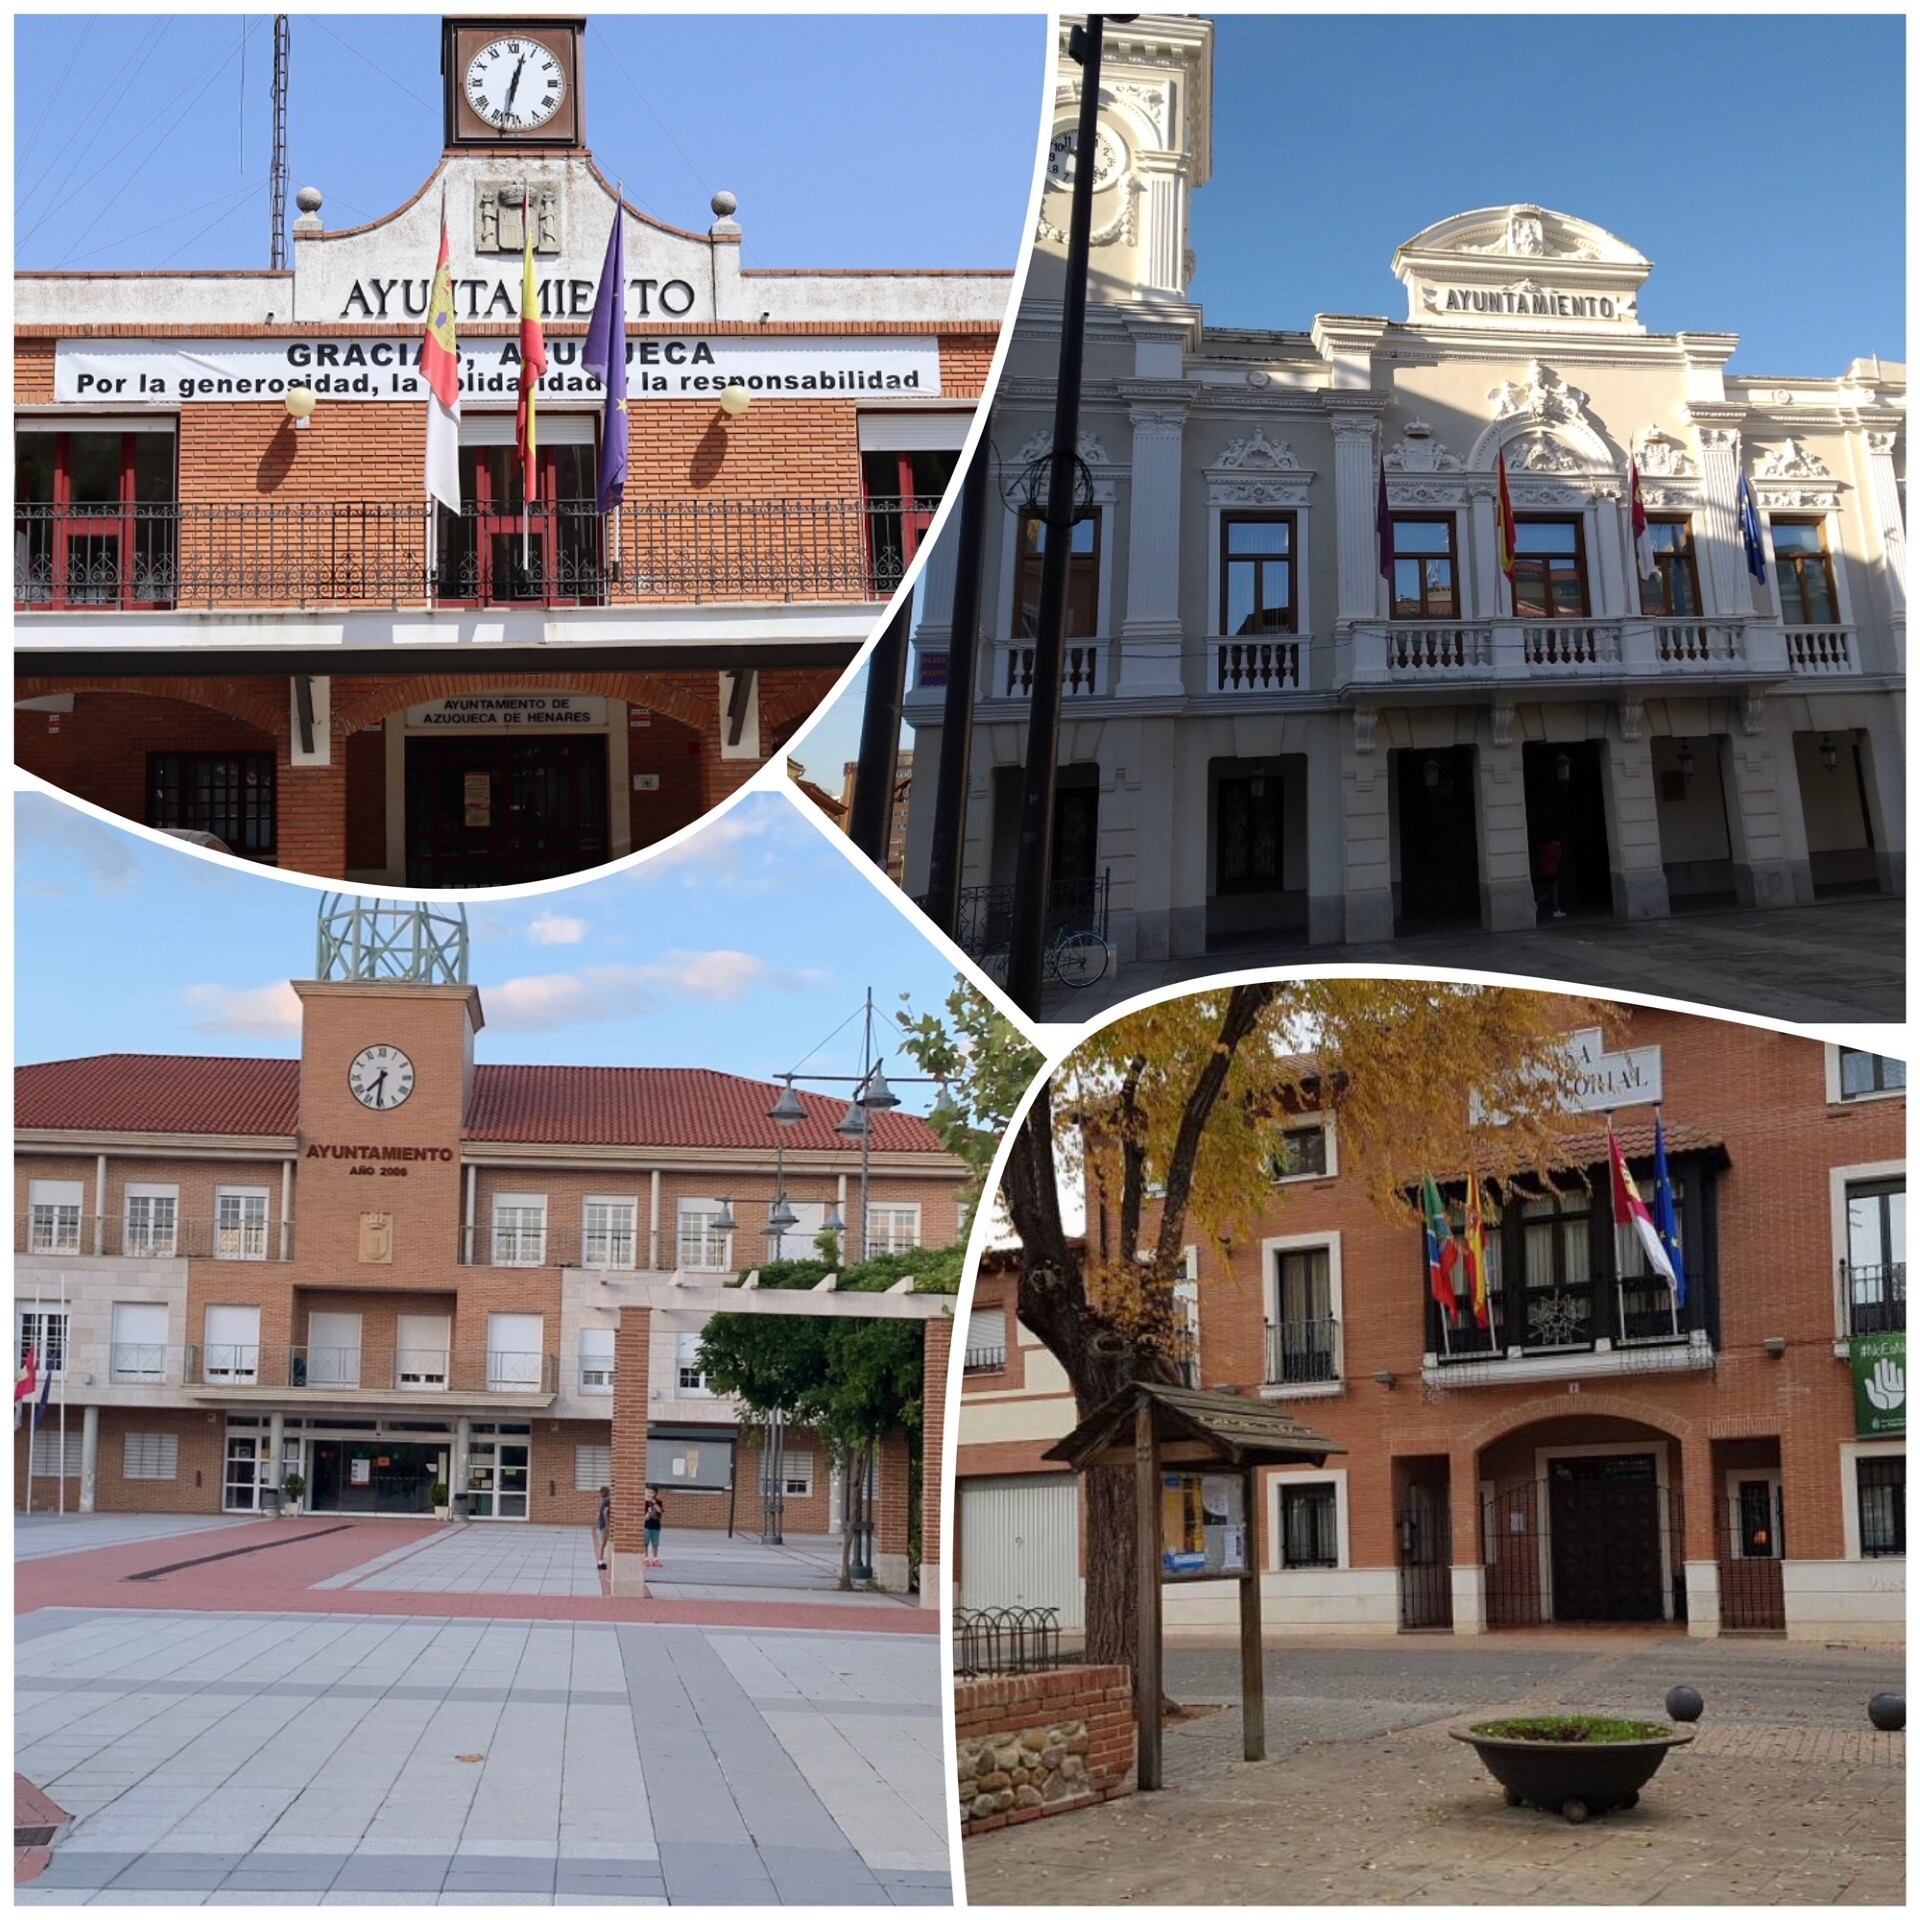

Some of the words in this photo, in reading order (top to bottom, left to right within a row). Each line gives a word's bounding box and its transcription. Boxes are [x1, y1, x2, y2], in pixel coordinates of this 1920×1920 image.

[1054, 142, 1064, 152] 10
[1064, 136, 1071, 147] 11
[1049, 152, 1055, 162] 9
[1103, 147, 1110, 157] 2
[1052, 164, 1059, 174] 8
[1064, 172, 1070, 181] 7
[1446, 288, 1615, 318] AYUNTAMIENTO
[77, 374, 126, 393] Por
[140, 374, 165, 393] la
[179, 373, 379, 398] generosidad,
[392, 374, 417, 392] la
[642, 372, 676, 391] la
[444, 699, 545, 710] AYUNTAMIENTO
[552, 699, 570, 709] DE
[423, 712, 497, 724] AZUQUECA
[504, 712, 521, 723] DE
[528, 711, 591, 722] HENARES
[306, 1144, 453, 1162] AYUNTAMIENTO
[350, 1165, 375, 1176] AÑO
